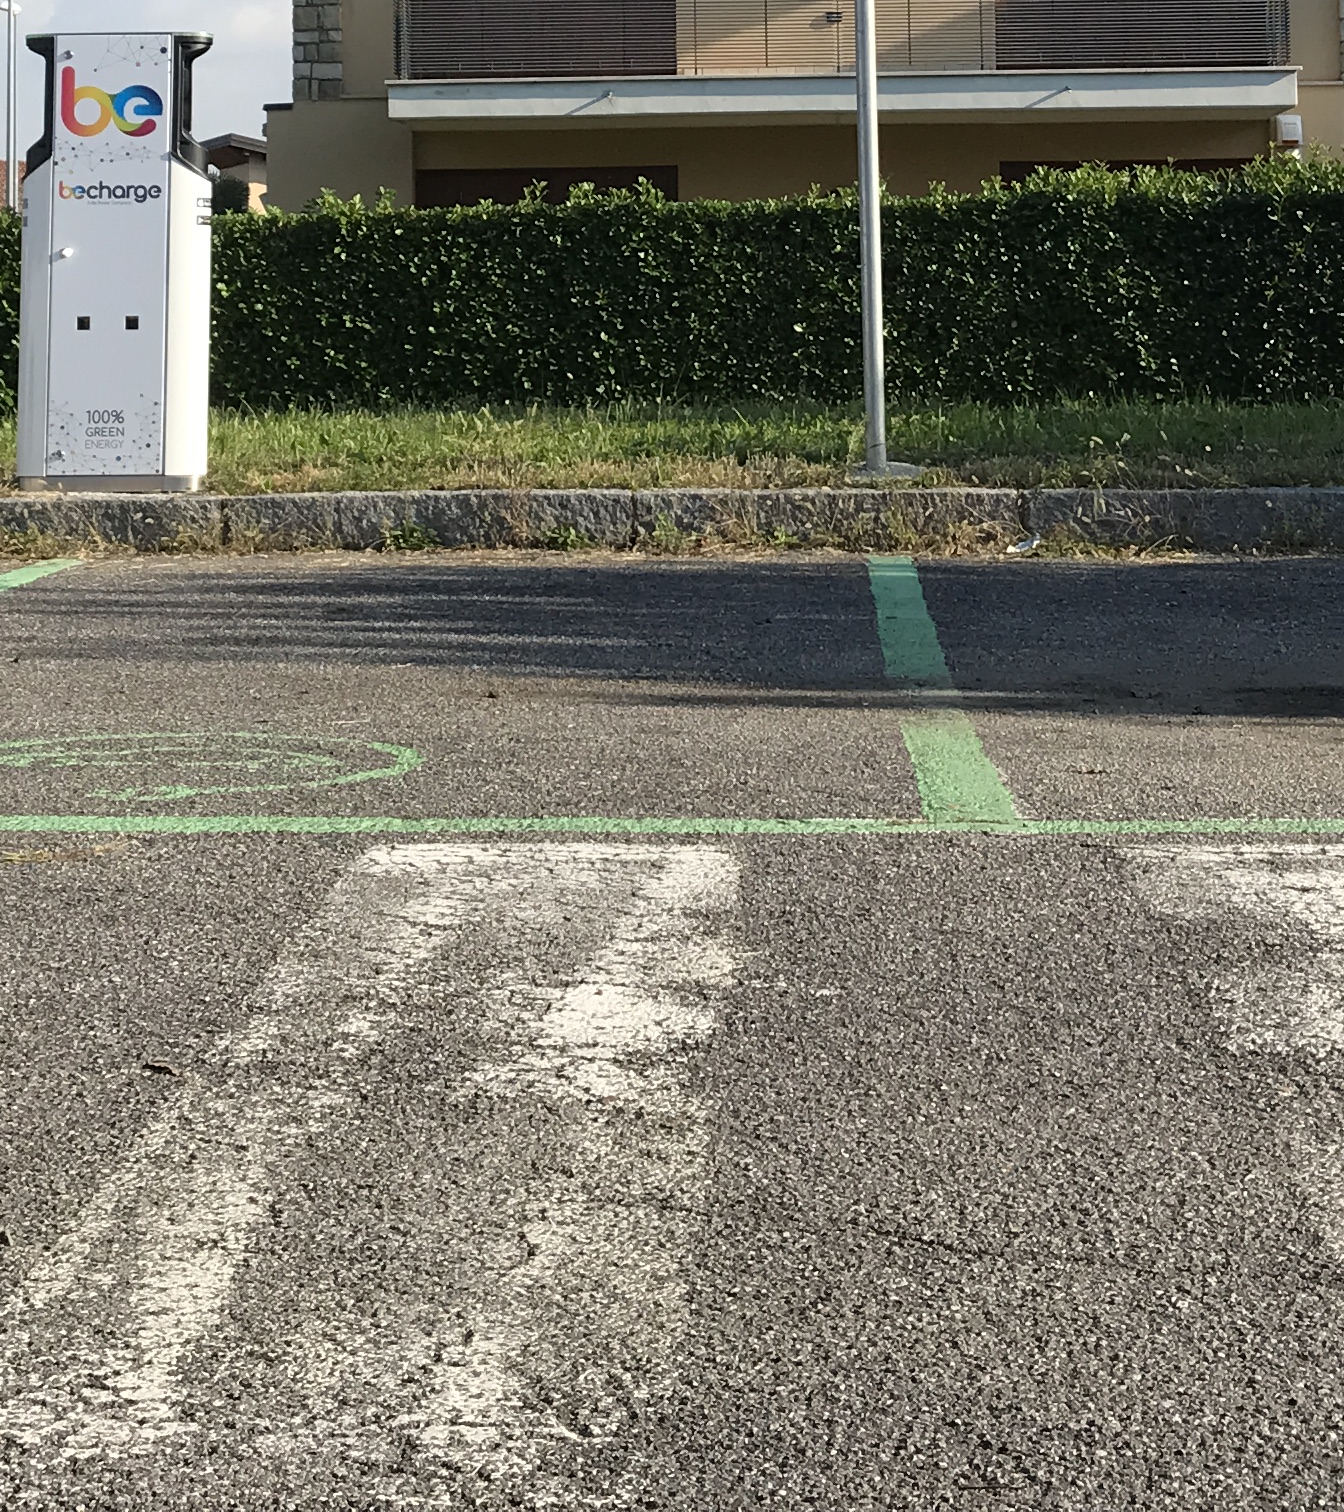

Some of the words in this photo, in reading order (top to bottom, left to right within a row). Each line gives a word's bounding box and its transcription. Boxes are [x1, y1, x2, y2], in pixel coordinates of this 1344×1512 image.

[60, 65, 164, 138] be
[58, 179, 162, 204] becharge
[85, 409, 125, 424] 100%
[84, 426, 125, 437] GREEN
[84, 439, 125, 449] ENERGY
